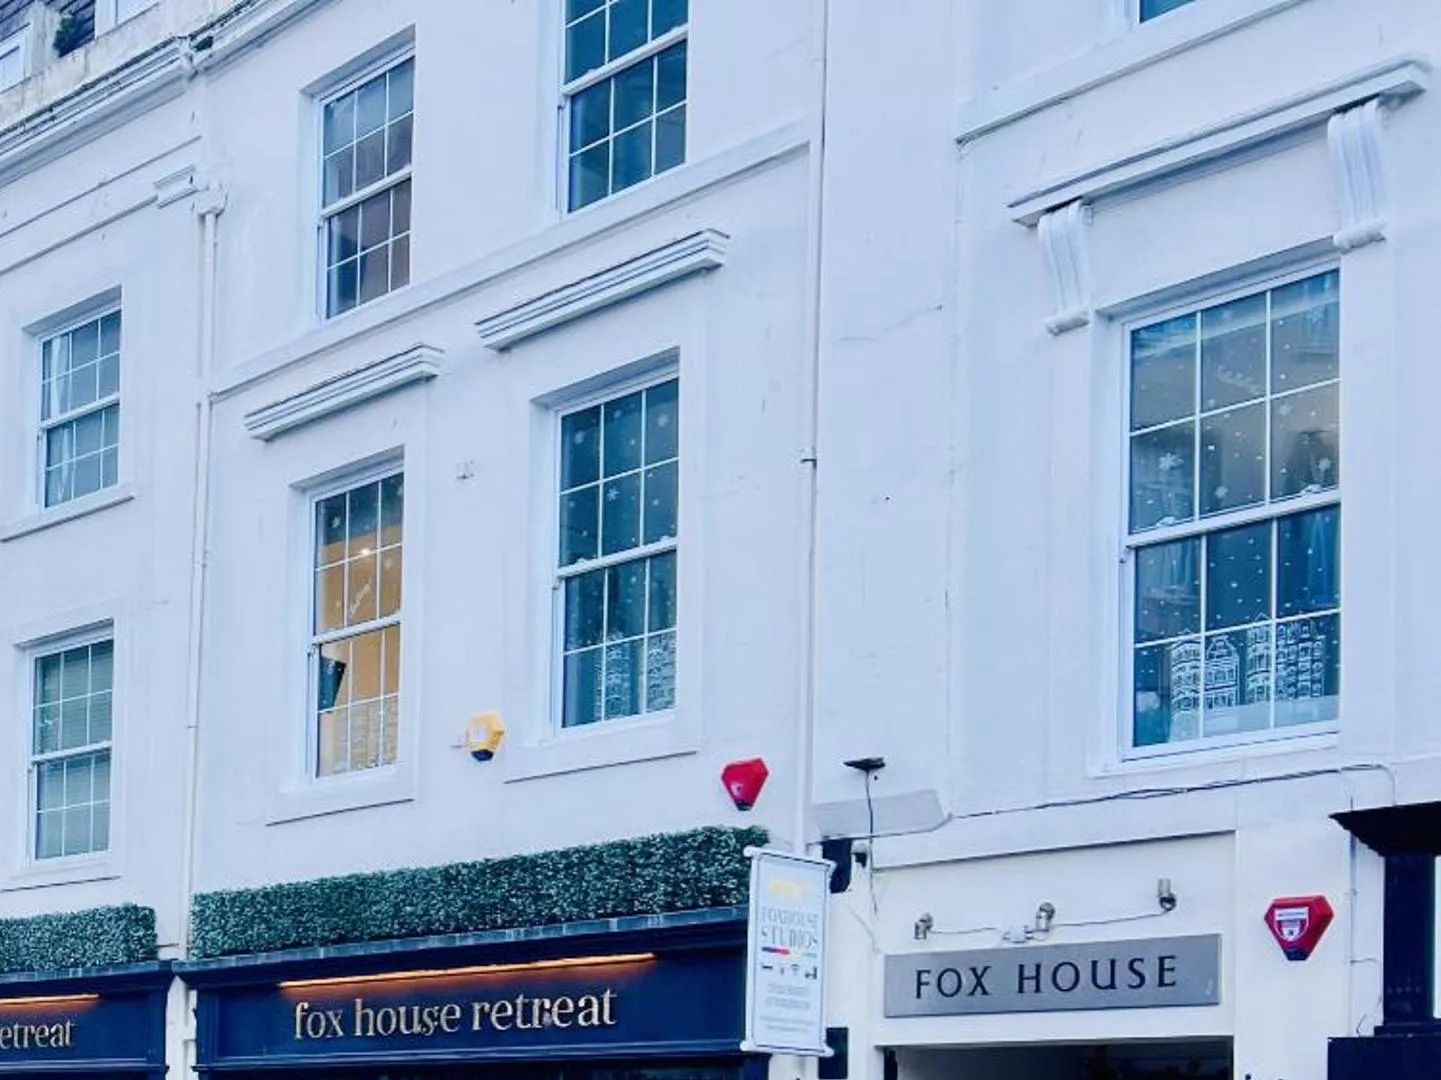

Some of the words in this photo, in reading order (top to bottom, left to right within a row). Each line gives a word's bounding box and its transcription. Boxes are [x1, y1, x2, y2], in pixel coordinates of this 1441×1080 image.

[915, 965, 993, 999] FOX
[1017, 955, 1177, 995] HOUSE
[293, 1001, 344, 1040] fox
[354, 998, 461, 1037] house
[471, 988, 618, 1031] retreat
